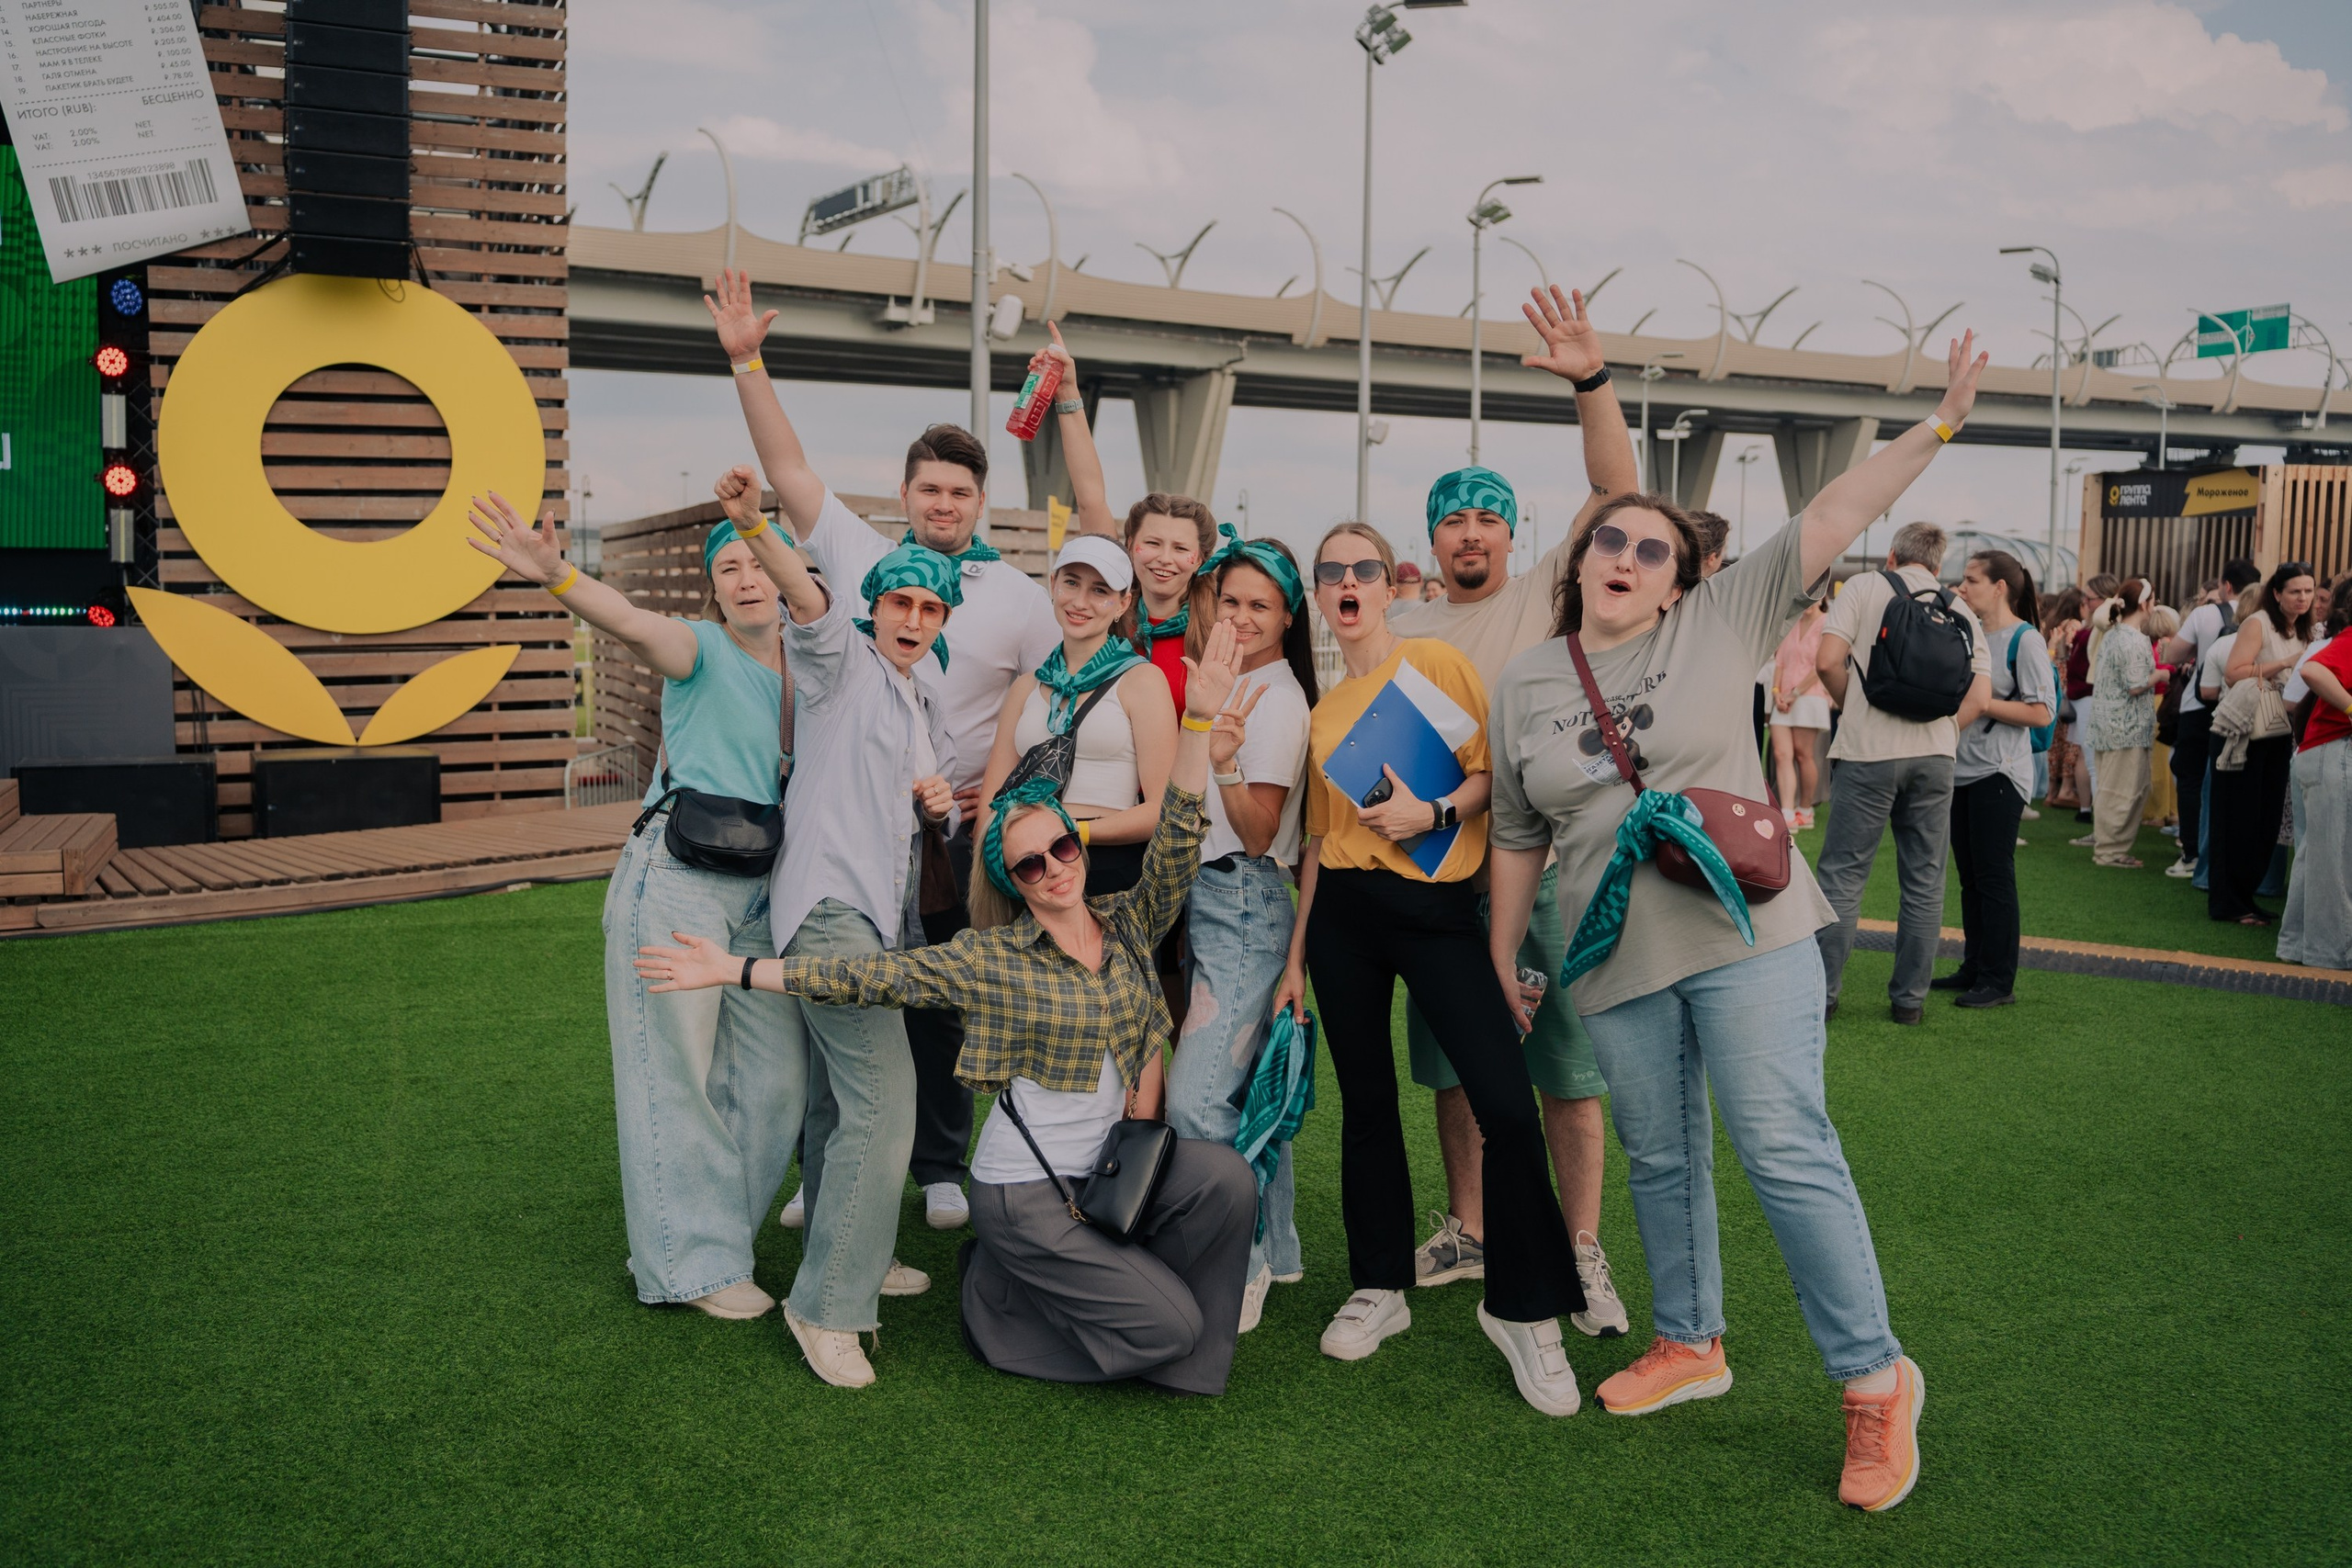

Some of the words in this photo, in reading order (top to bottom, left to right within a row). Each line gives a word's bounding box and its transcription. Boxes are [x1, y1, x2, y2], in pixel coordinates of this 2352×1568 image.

[21, 0, 63, 9] ПАРТНЕРЫ
[25, 9, 78, 21] НАБЕРЕЖНАЯ
[28, 22, 70, 33] ХОРОШАЯ
[72, 19, 107, 28] ПОГОДА
[32, 34, 76, 45] КЛАССНЫЕ
[77, 31, 107, 40] ФОТКИ
[36, 44, 88, 57] НАСТРОЕНИЕ
[89, 43, 102, 51] НА
[102, 39, 134, 50] ВЫСОТЕ
[39, 60, 61, 69] МАМ
[74, 55, 103, 65] ТЕЛЕКЕ
[42, 72, 62, 81] ГАЛЯ
[63, 69, 97, 78] ОТМЕНА
[45, 81, 82, 92] ПАКЕТИК
[83, 79, 106, 88] БРАТЬ
[107, 75, 134, 85] БУДЕТЕ
[17, 107, 59, 119] ИТОГО
[62, 102, 97, 117] (RUB):
[141, 89, 205, 106] БЕСЦЕННО
[32, 132, 51, 141] VAT:
[70, 127, 98, 137] 2.00%
[35, 142, 53, 151] VAT:
[73, 137, 100, 147] 2.00%
[113, 232, 188, 253] ПОСЧИТАНО
[2197, 487, 2249, 499] Мороженое
[1552, 710, 1593, 736] NOT
